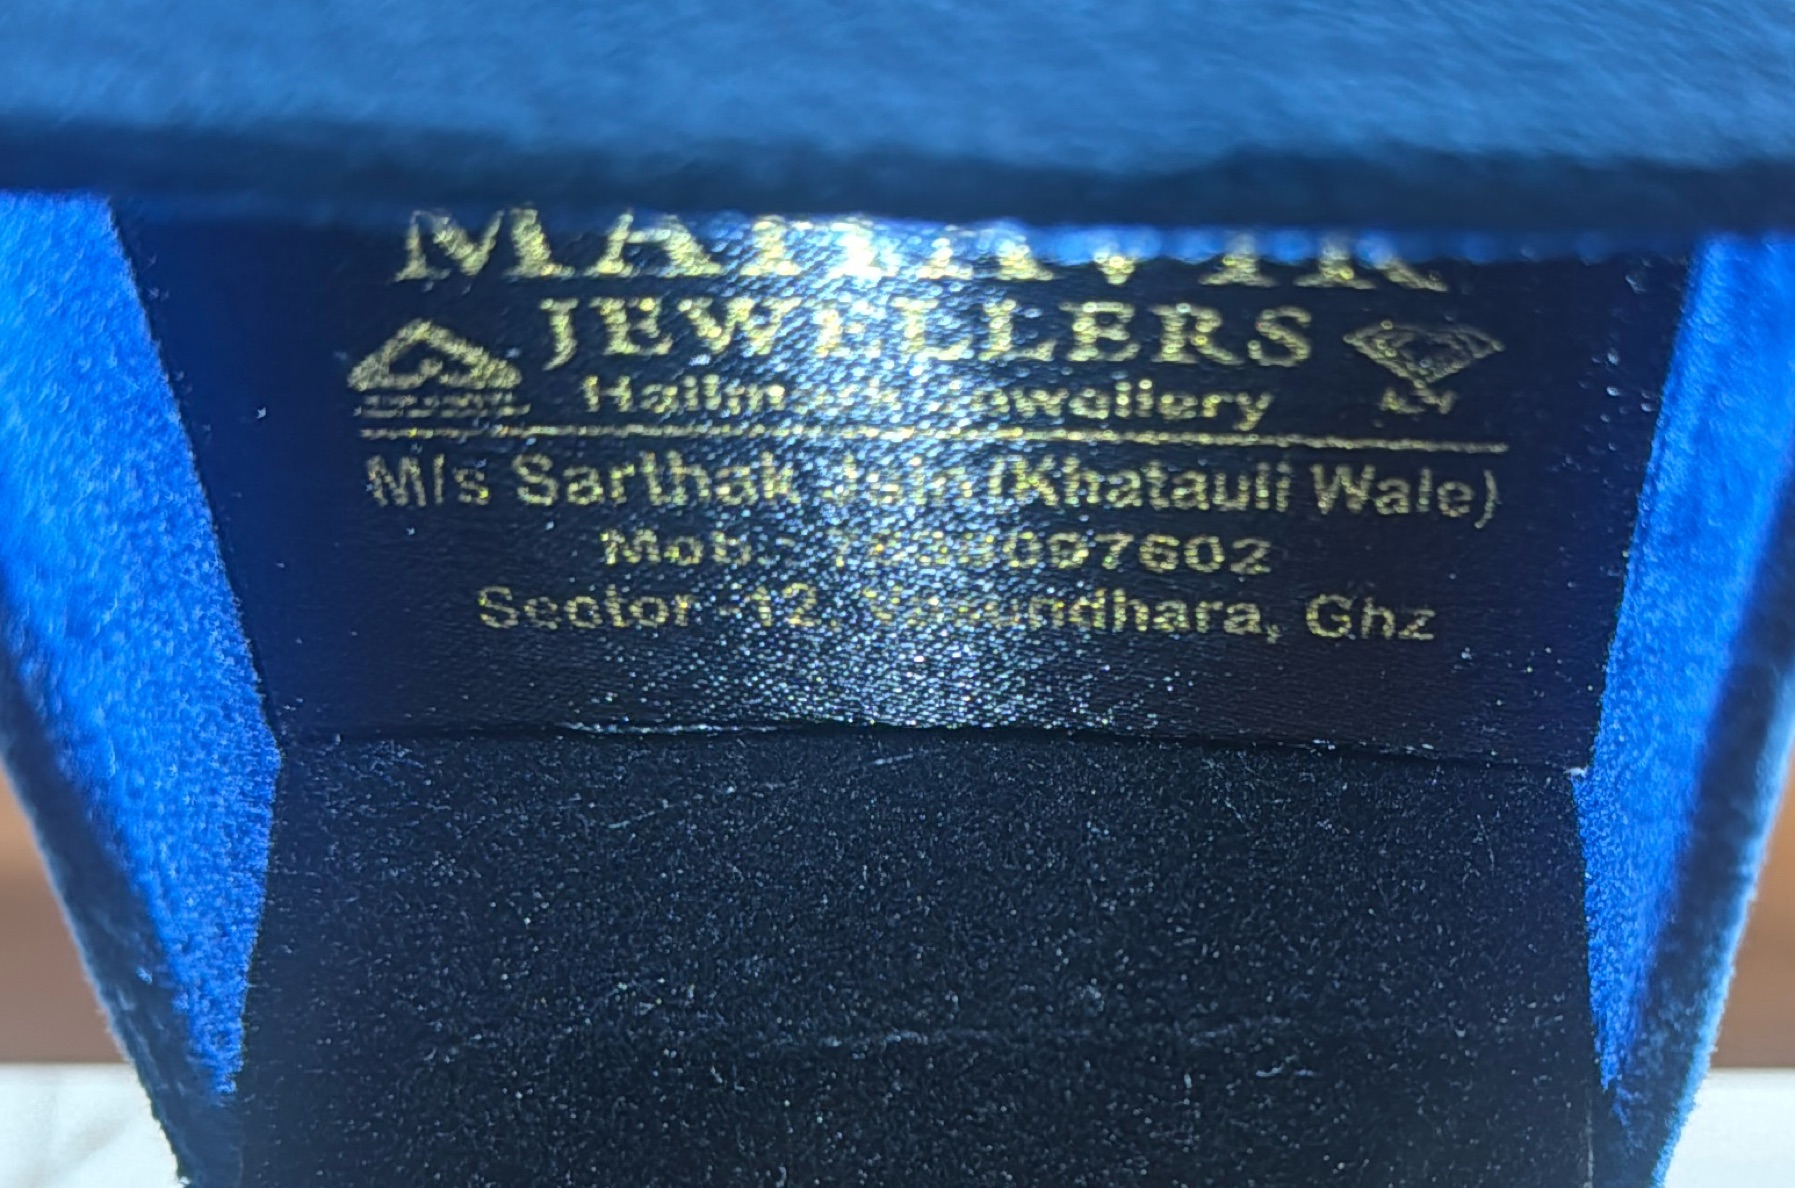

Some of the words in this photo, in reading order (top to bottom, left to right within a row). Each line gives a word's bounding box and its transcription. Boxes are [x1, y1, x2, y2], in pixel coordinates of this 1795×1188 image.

[540, 297, 1313, 371] JEWELLERS
[511, 449, 798, 507] Sarthak
[1309, 460, 1502, 528] Wale)
[477, 584, 693, 631] Sector
[1306, 593, 1436, 640] Ghz
